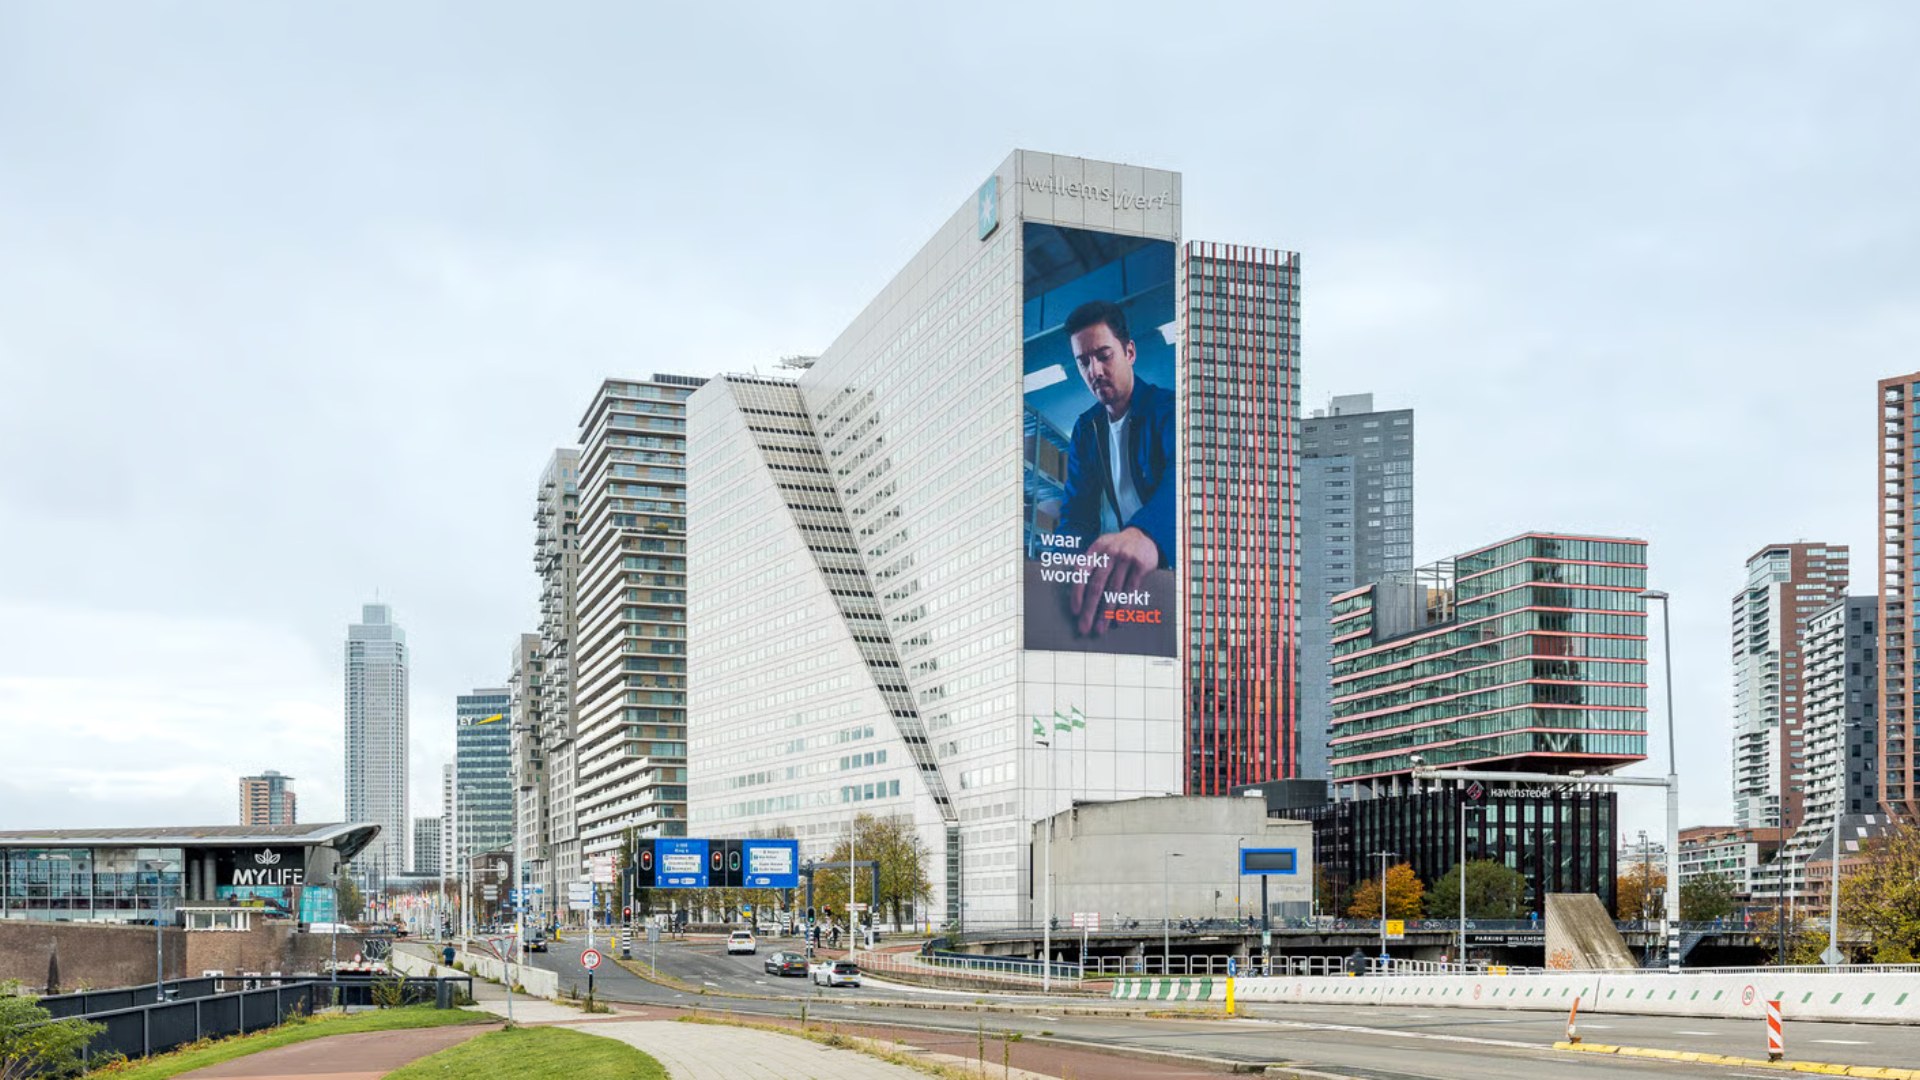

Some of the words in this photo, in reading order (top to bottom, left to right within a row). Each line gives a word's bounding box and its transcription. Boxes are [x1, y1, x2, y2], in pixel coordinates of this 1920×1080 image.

[1040, 533, 1082, 549] waar
[1040, 551, 1110, 569] gewerkt
[1040, 569, 1091, 585] wordt
[1104, 590, 1151, 606] werkt
[460, 716, 474, 726] EY
[232, 868, 303, 886] MYLIFE
